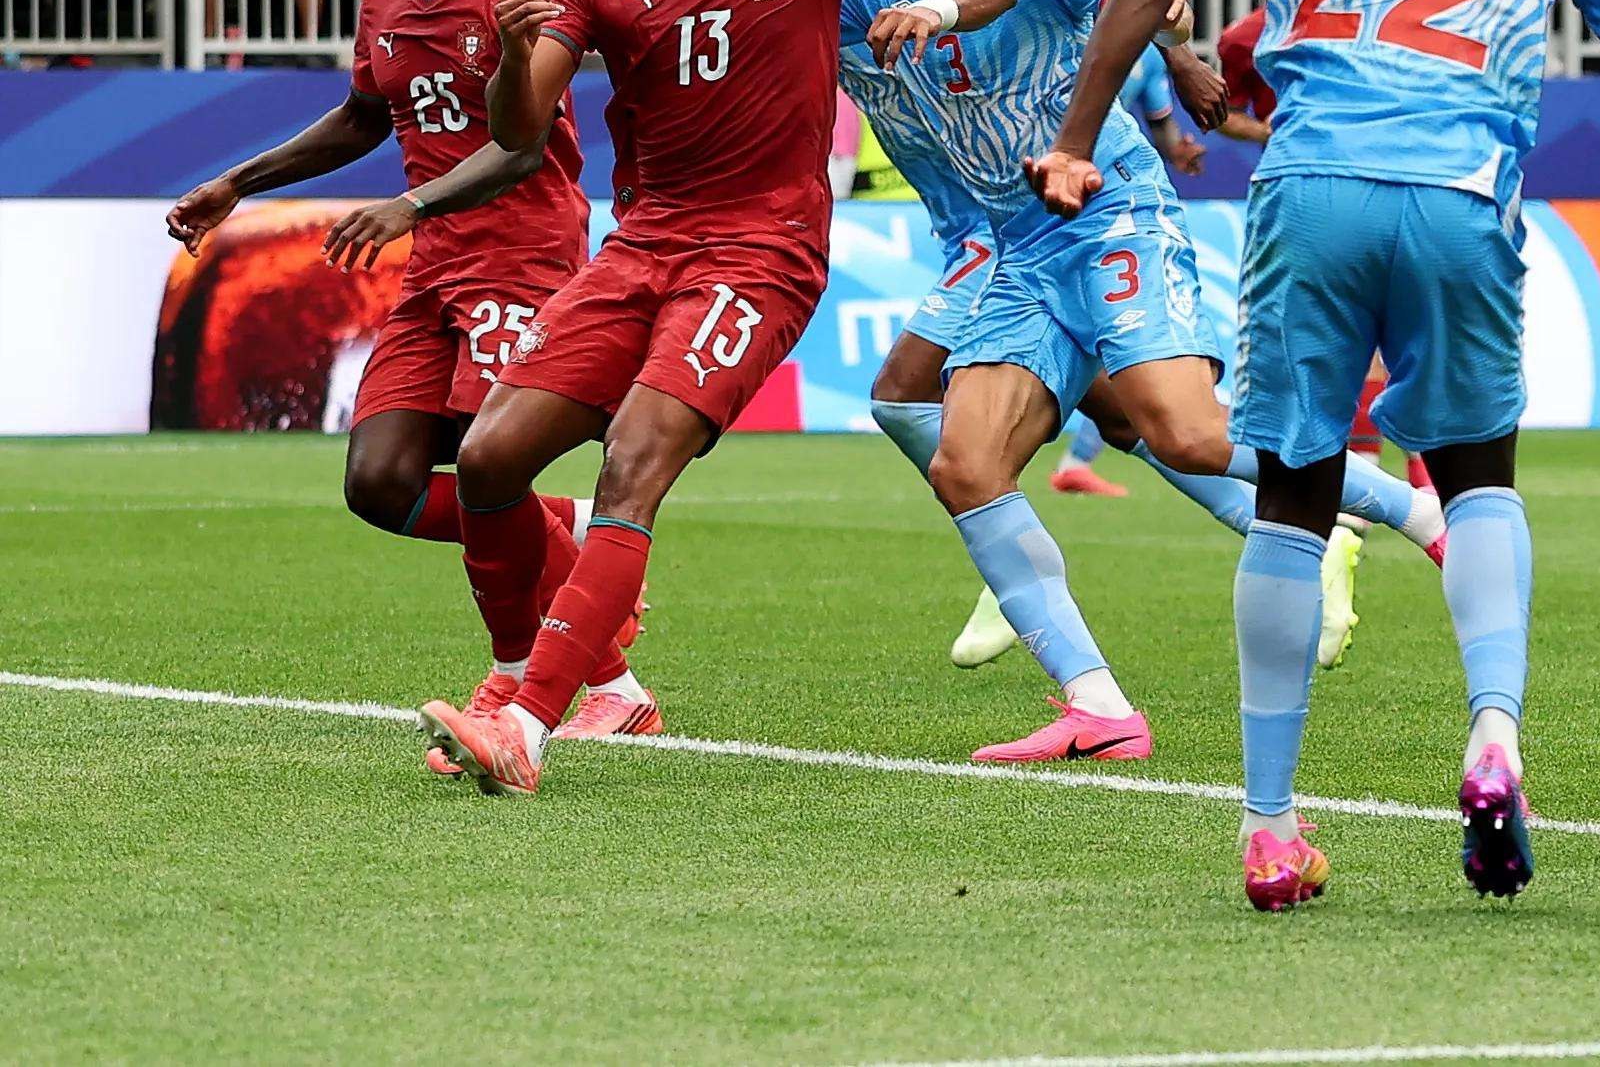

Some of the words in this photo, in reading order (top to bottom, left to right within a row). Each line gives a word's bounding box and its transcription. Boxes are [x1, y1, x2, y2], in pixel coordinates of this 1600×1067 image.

[675, 9, 732, 87] 13
[935, 33, 973, 95] 3
[408, 72, 470, 134] 25
[943, 239, 993, 289] 7
[1099, 249, 1141, 304] 3
[469, 299, 535, 367] 25
[693, 283, 763, 368] 13
